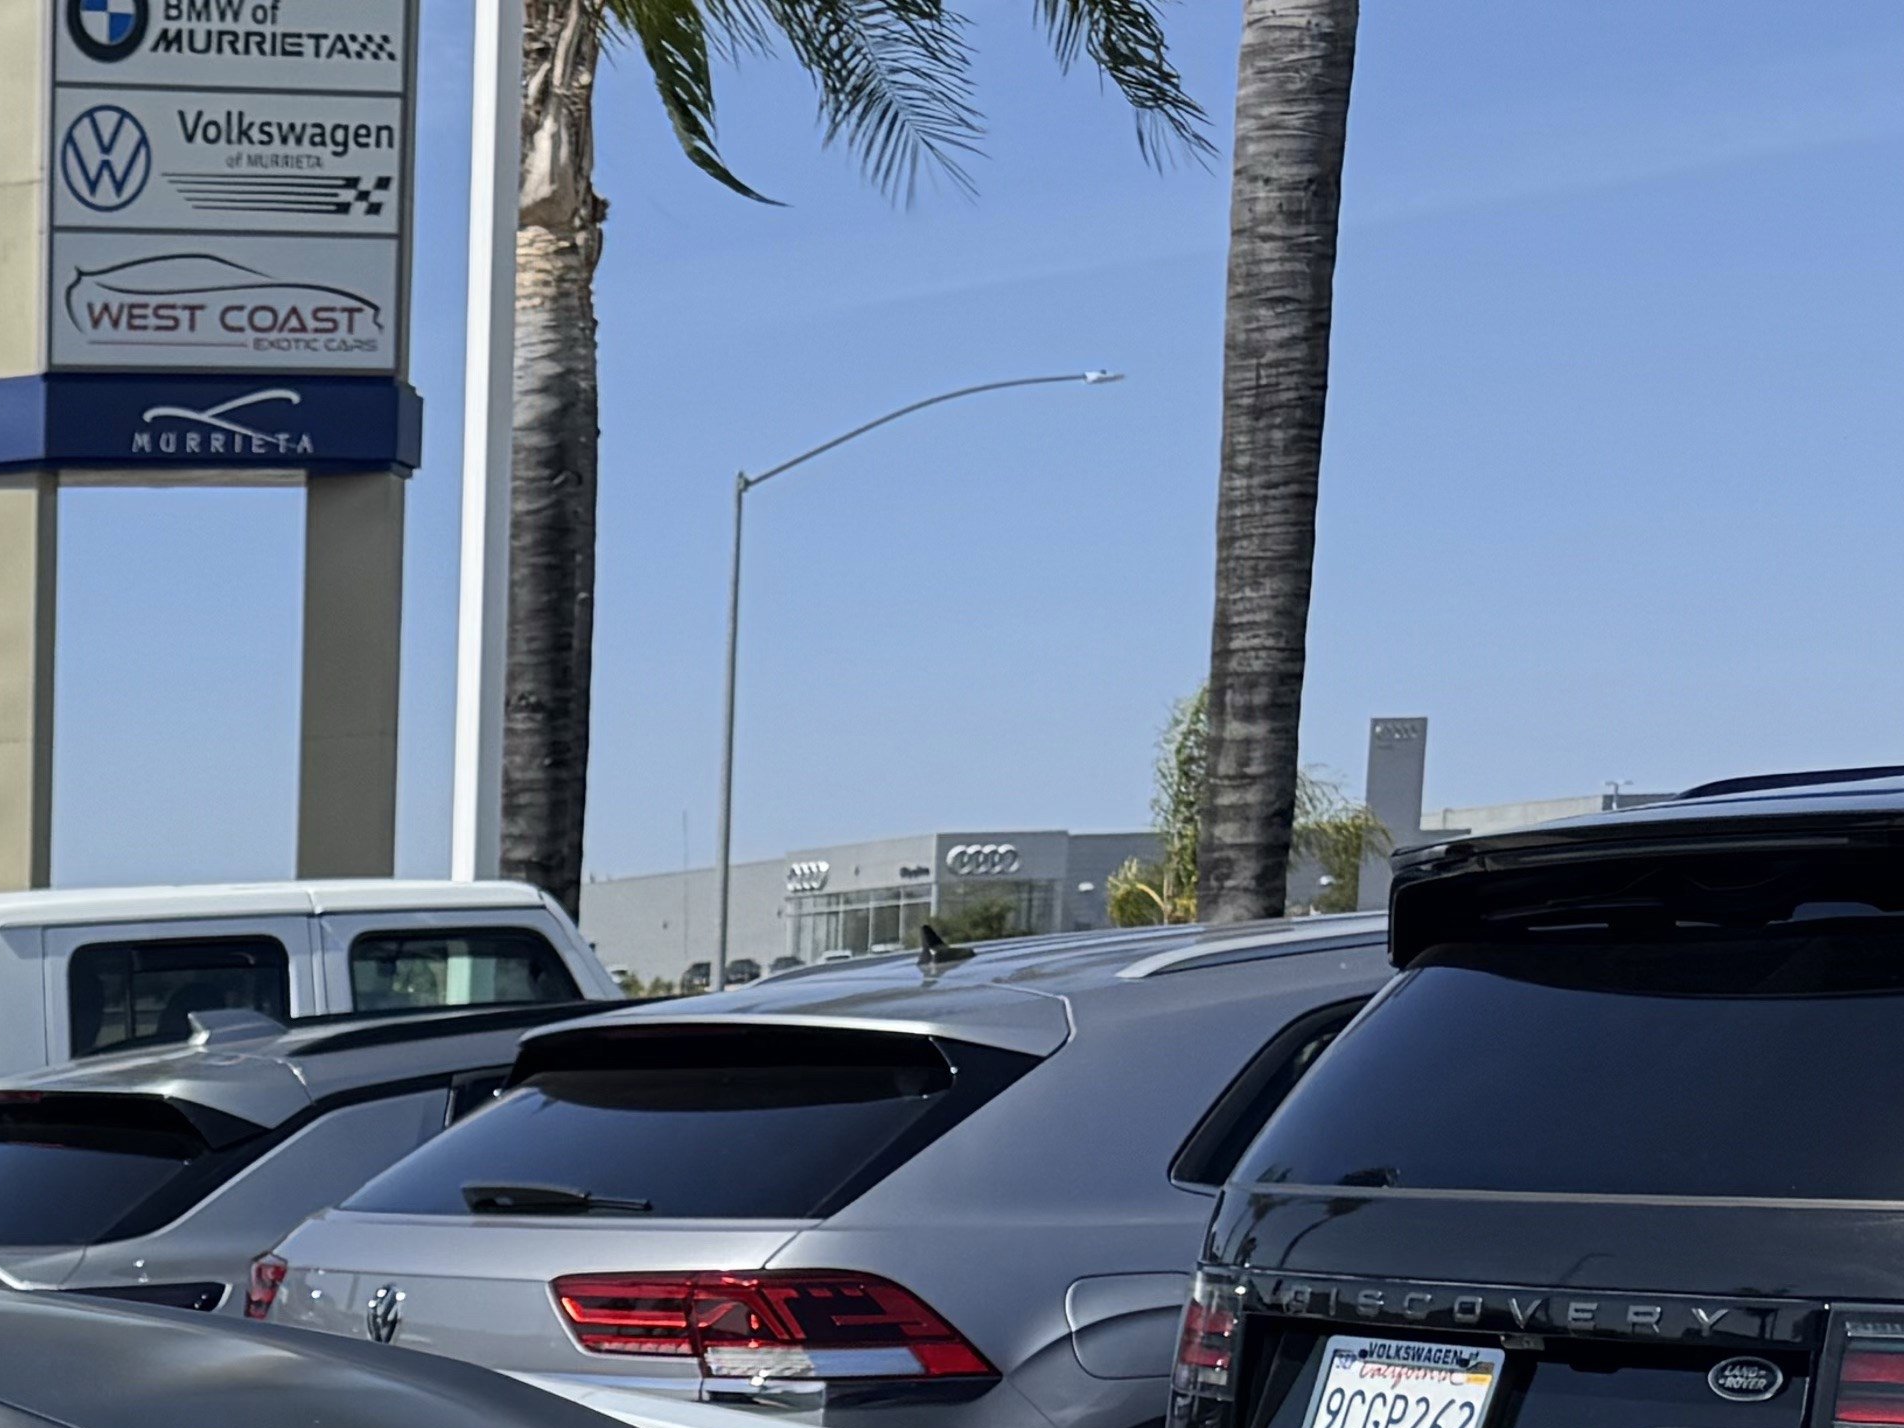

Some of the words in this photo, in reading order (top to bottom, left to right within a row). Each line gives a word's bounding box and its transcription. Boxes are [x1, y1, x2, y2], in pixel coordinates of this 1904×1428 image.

[164, 0, 244, 22] BMW
[251, 0, 280, 24] of
[150, 28, 353, 60] MURRIETA
[178, 110, 395, 158] Volkswagen
[226, 153, 243, 169] of
[247, 154, 324, 170] MURRIETA
[87, 302, 207, 332] WEST
[220, 305, 364, 335] COAST
[253, 337, 319, 352] EXOTIC
[324, 338, 379, 352] CARS
[131, 431, 314, 455] MURRIETA
[1282, 1284, 1730, 1337] DISCOVERY
[1368, 1341, 1464, 1366] VOLKSWAGEN
